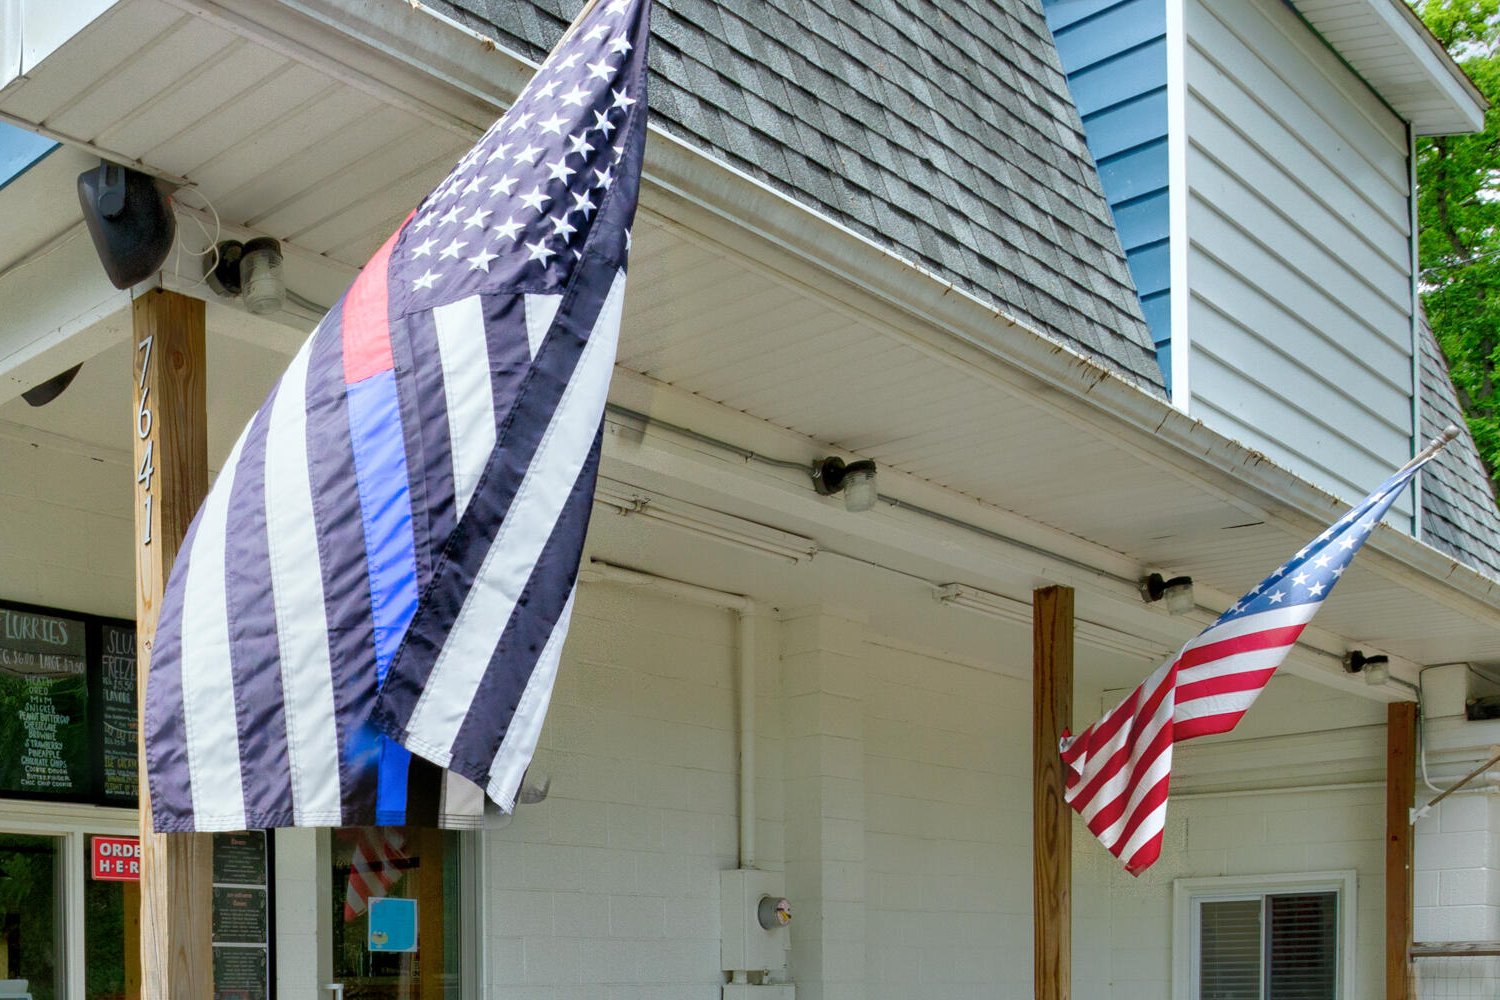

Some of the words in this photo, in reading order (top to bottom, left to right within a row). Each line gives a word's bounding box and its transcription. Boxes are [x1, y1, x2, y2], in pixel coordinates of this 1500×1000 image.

[138, 335, 154, 545] 7641
[24, 675, 53, 687] HEATH
[28, 686, 49, 696] OREO
[100, 843, 140, 858] ORDE
